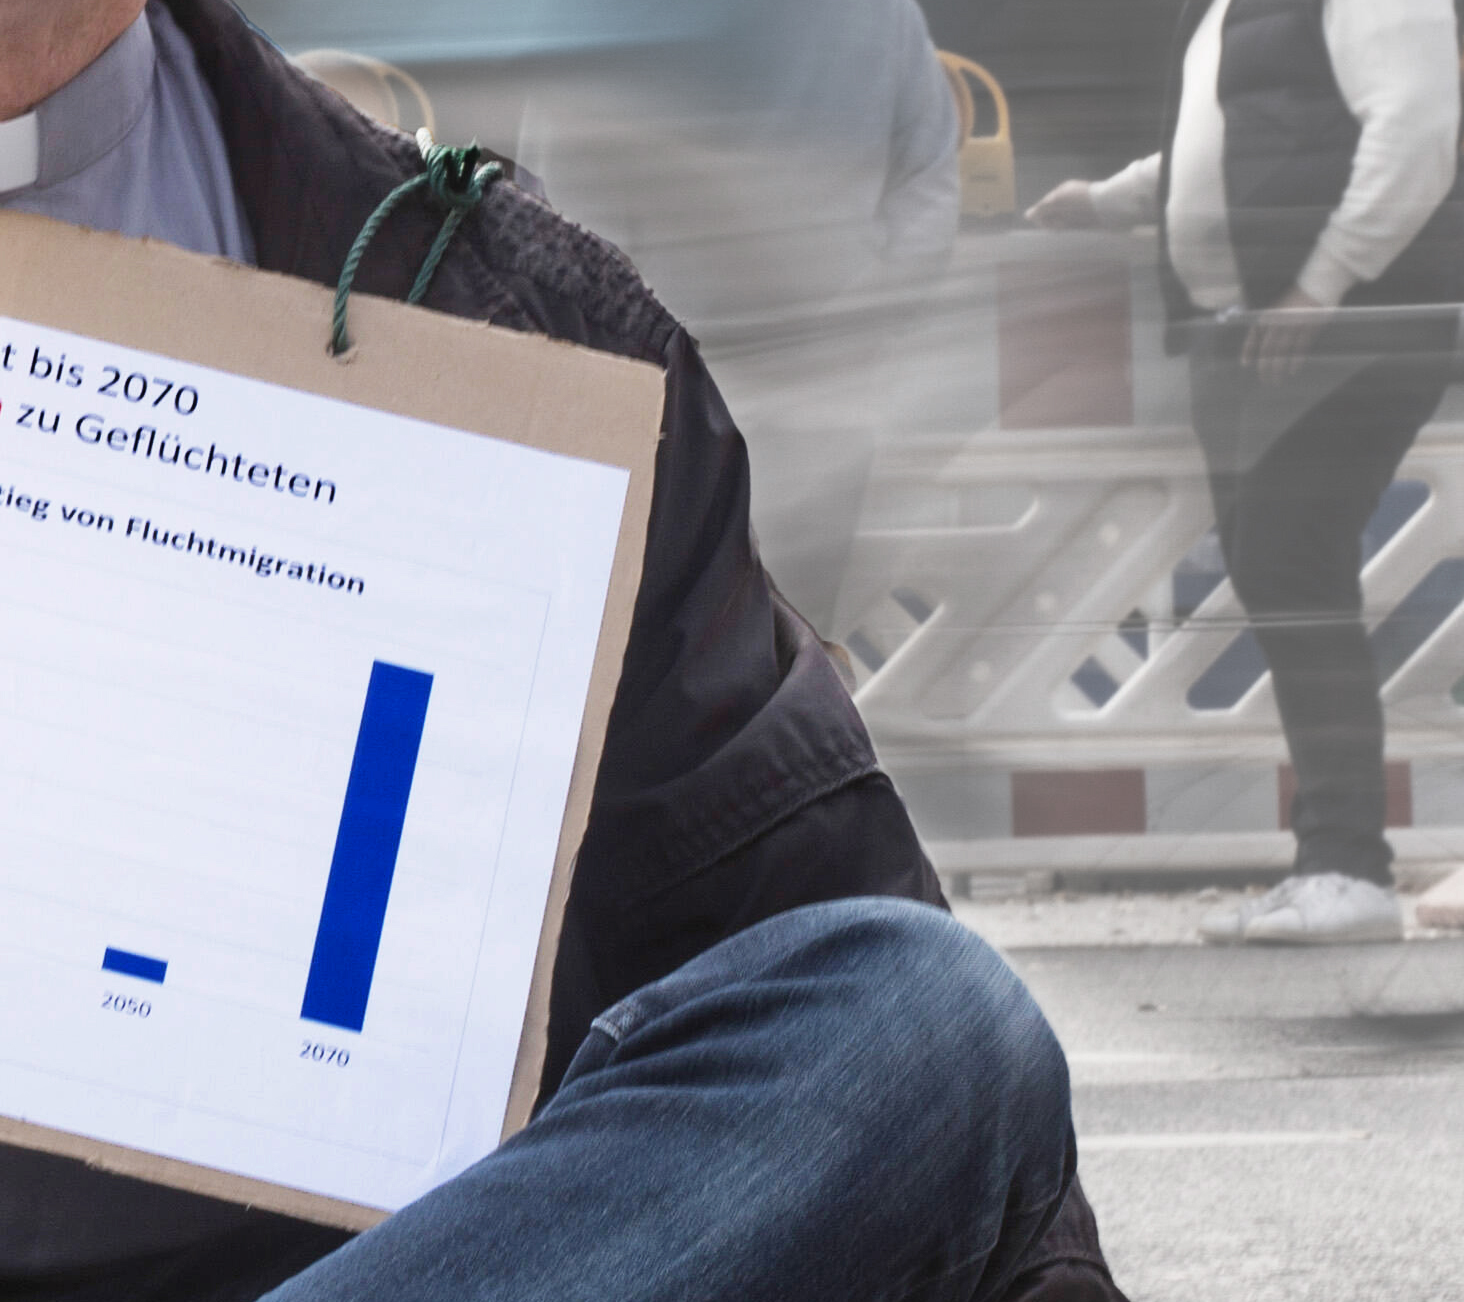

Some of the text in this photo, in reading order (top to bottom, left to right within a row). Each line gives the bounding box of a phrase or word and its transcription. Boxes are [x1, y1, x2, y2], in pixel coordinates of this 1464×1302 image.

[29, 346, 84, 388] bis
[96, 365, 200, 417] 2070
[15, 402, 62, 434] zu
[75, 412, 338, 505] Geflüchteten
[61, 504, 114, 533] von
[125, 516, 366, 596] Fluchtmigration
[100, 991, 153, 1019] 2050
[298, 1038, 351, 1069] 2070
